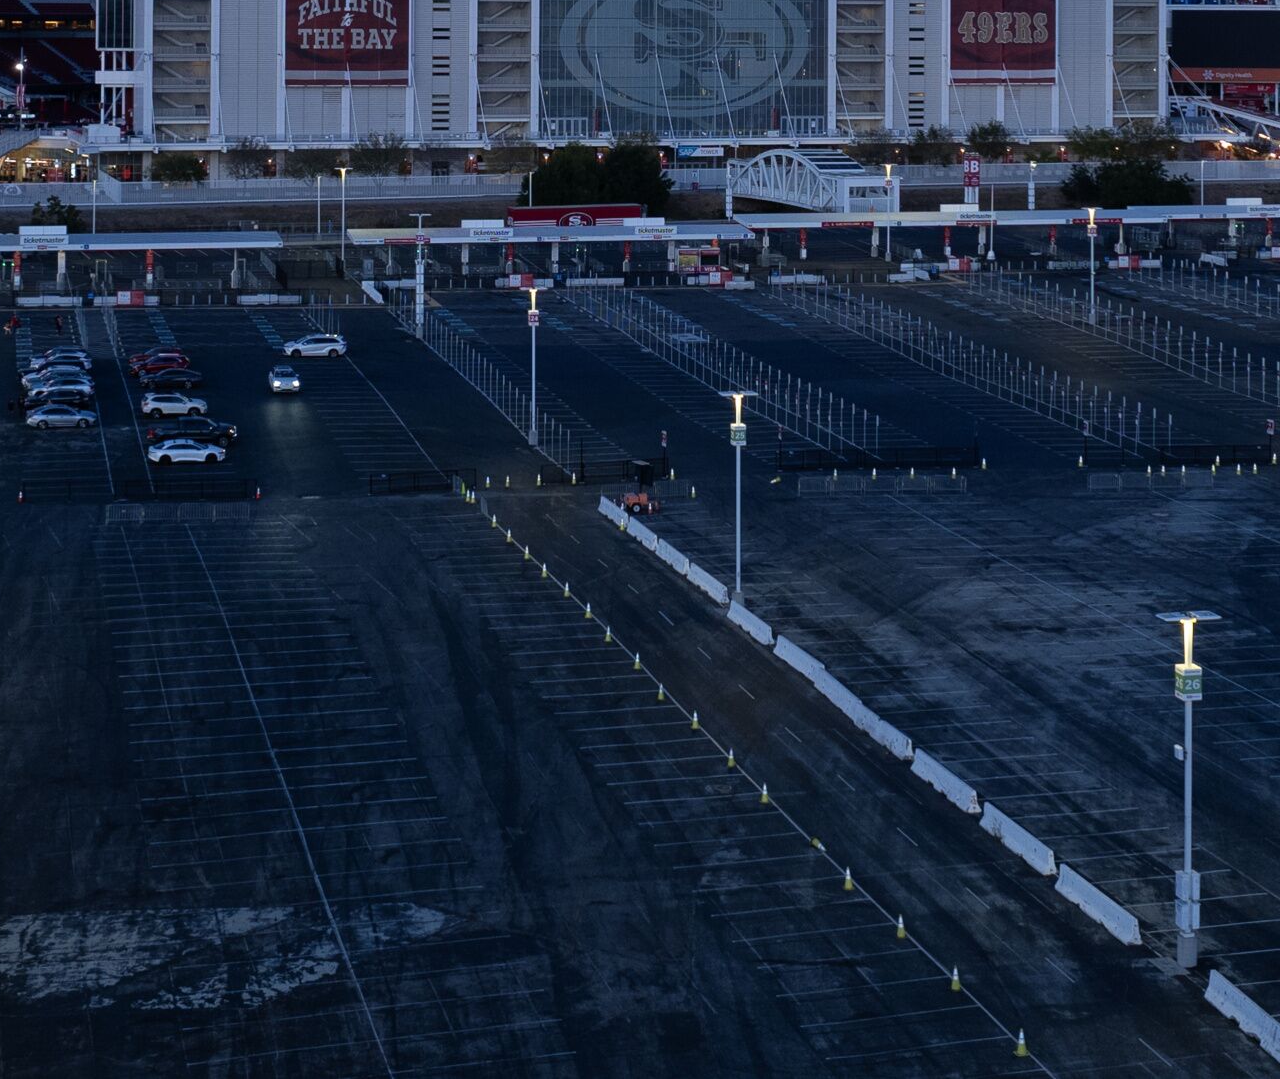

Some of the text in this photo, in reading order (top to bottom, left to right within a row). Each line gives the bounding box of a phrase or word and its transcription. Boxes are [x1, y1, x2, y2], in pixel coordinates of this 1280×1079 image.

[340, 13, 355, 27] to
[957, 10, 1049, 44] 49ERS
[298, 28, 397, 50] THE BAY
[735, 431, 745, 440] 25
[1185, 678, 1201, 691] 26
